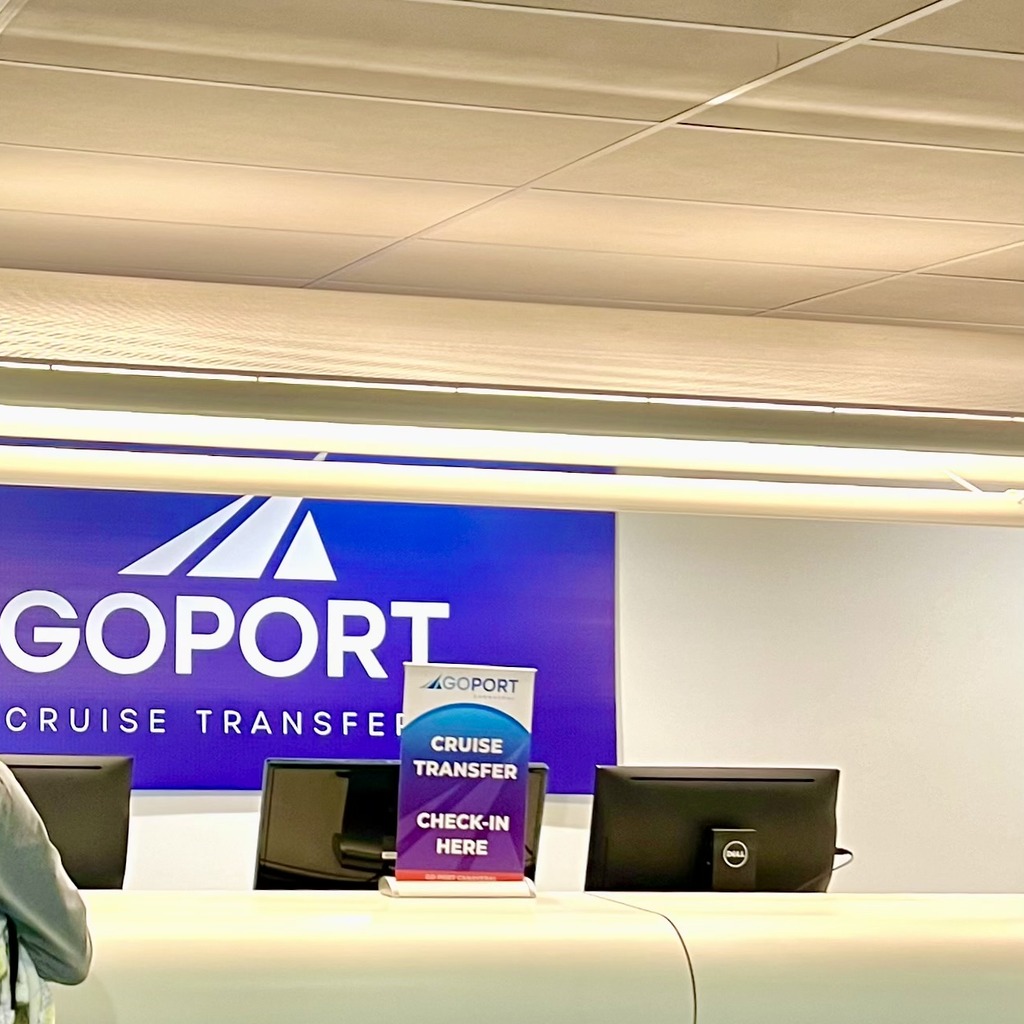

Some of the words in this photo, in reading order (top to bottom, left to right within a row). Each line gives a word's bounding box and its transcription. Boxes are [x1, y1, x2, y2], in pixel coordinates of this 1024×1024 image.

[442, 675, 519, 694] GOPORT
[5, 706, 167, 734] CRUISE
[430, 735, 504, 754] CRUISE
[413, 759, 518, 780] TRANSFER
[416, 812, 510, 832] CHECK-IN
[436, 838, 488, 856] HERE
[726, 850, 746, 858] DELL
